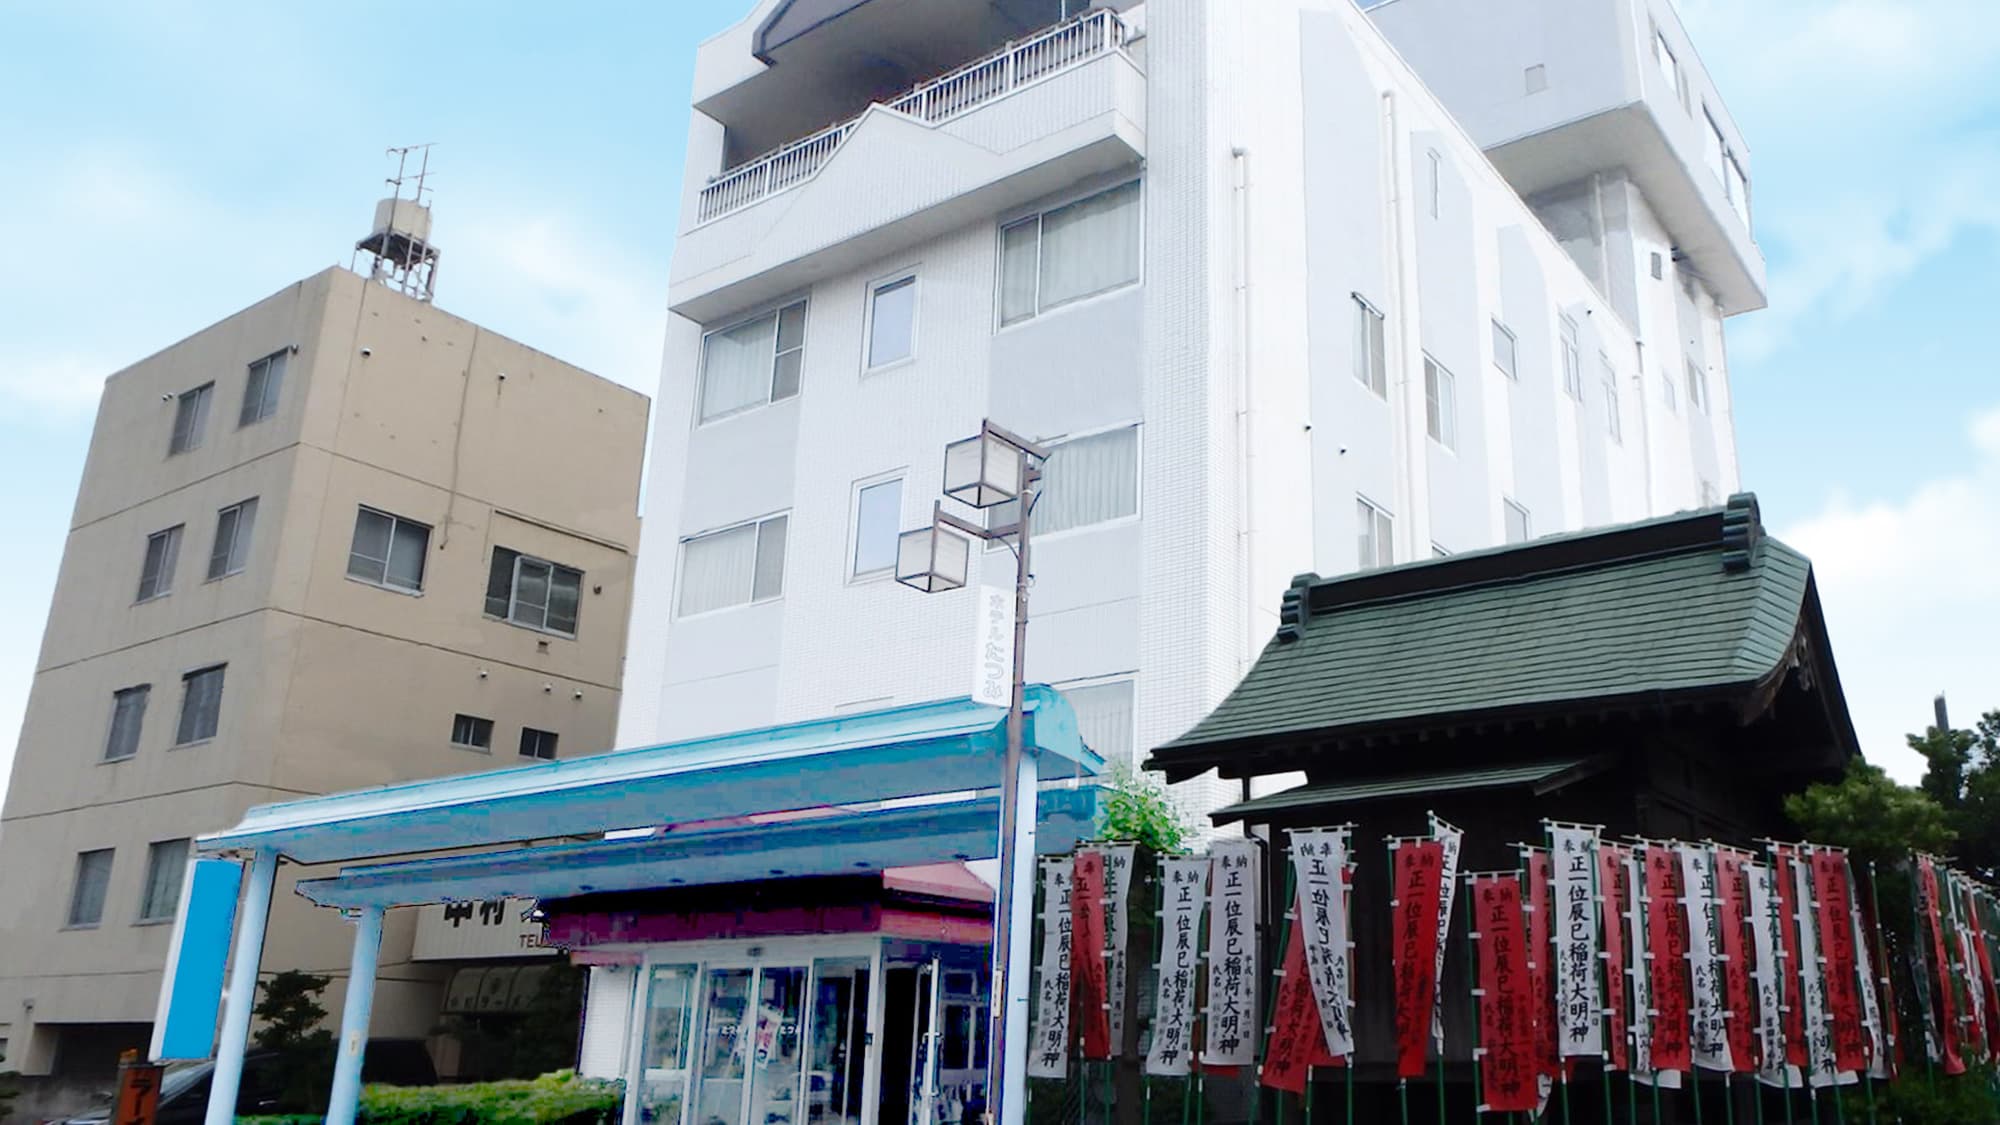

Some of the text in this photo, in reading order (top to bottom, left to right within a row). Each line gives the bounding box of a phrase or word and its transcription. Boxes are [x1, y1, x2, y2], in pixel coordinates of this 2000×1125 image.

[1222, 855, 1248, 869] 奉納
[1172, 870, 1199, 885] 奉納
[1568, 856, 1589, 1043] 正一位辰巳稲荷大明神
[1218, 872, 1244, 1055] 正一位辰巳稲荷大明神
[1160, 887, 1193, 1067] 正一位辰巳稲荷大明神
[1212, 965, 1222, 987] 氏名
[1696, 965, 1706, 988] 氏名
[1162, 977, 1173, 999] 氏名
